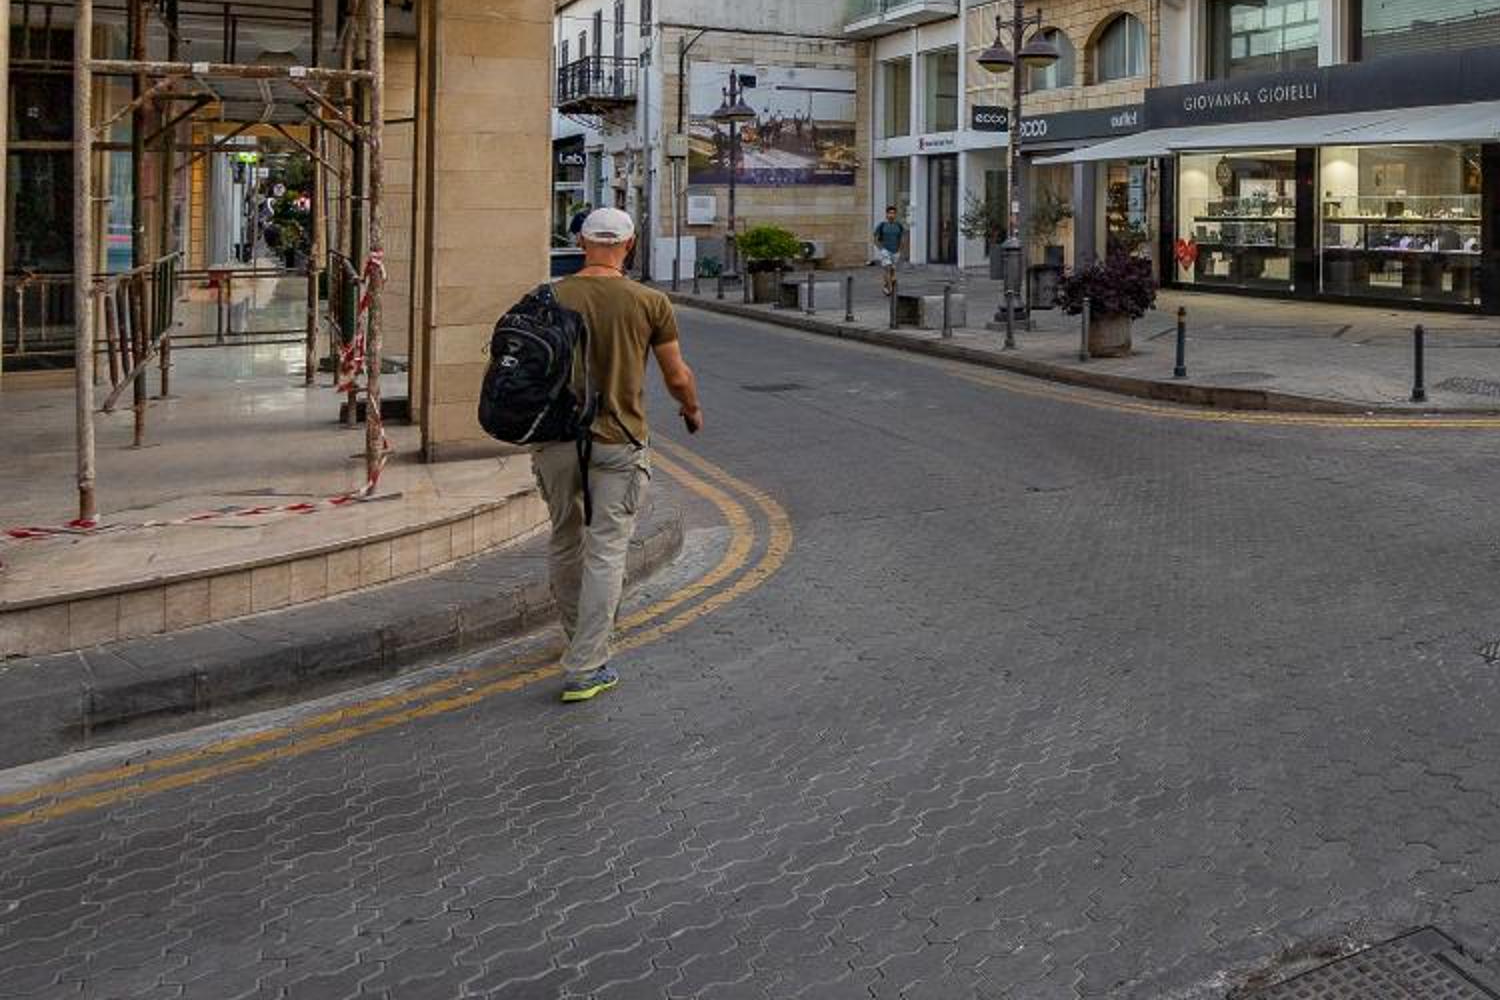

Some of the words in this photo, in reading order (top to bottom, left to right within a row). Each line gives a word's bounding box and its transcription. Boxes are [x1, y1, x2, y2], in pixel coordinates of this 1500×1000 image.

[1183, 91, 1251, 111] GIOVANNA
[1257, 82, 1317, 103] GIOIELLI
[975, 113, 1007, 124] ecco
